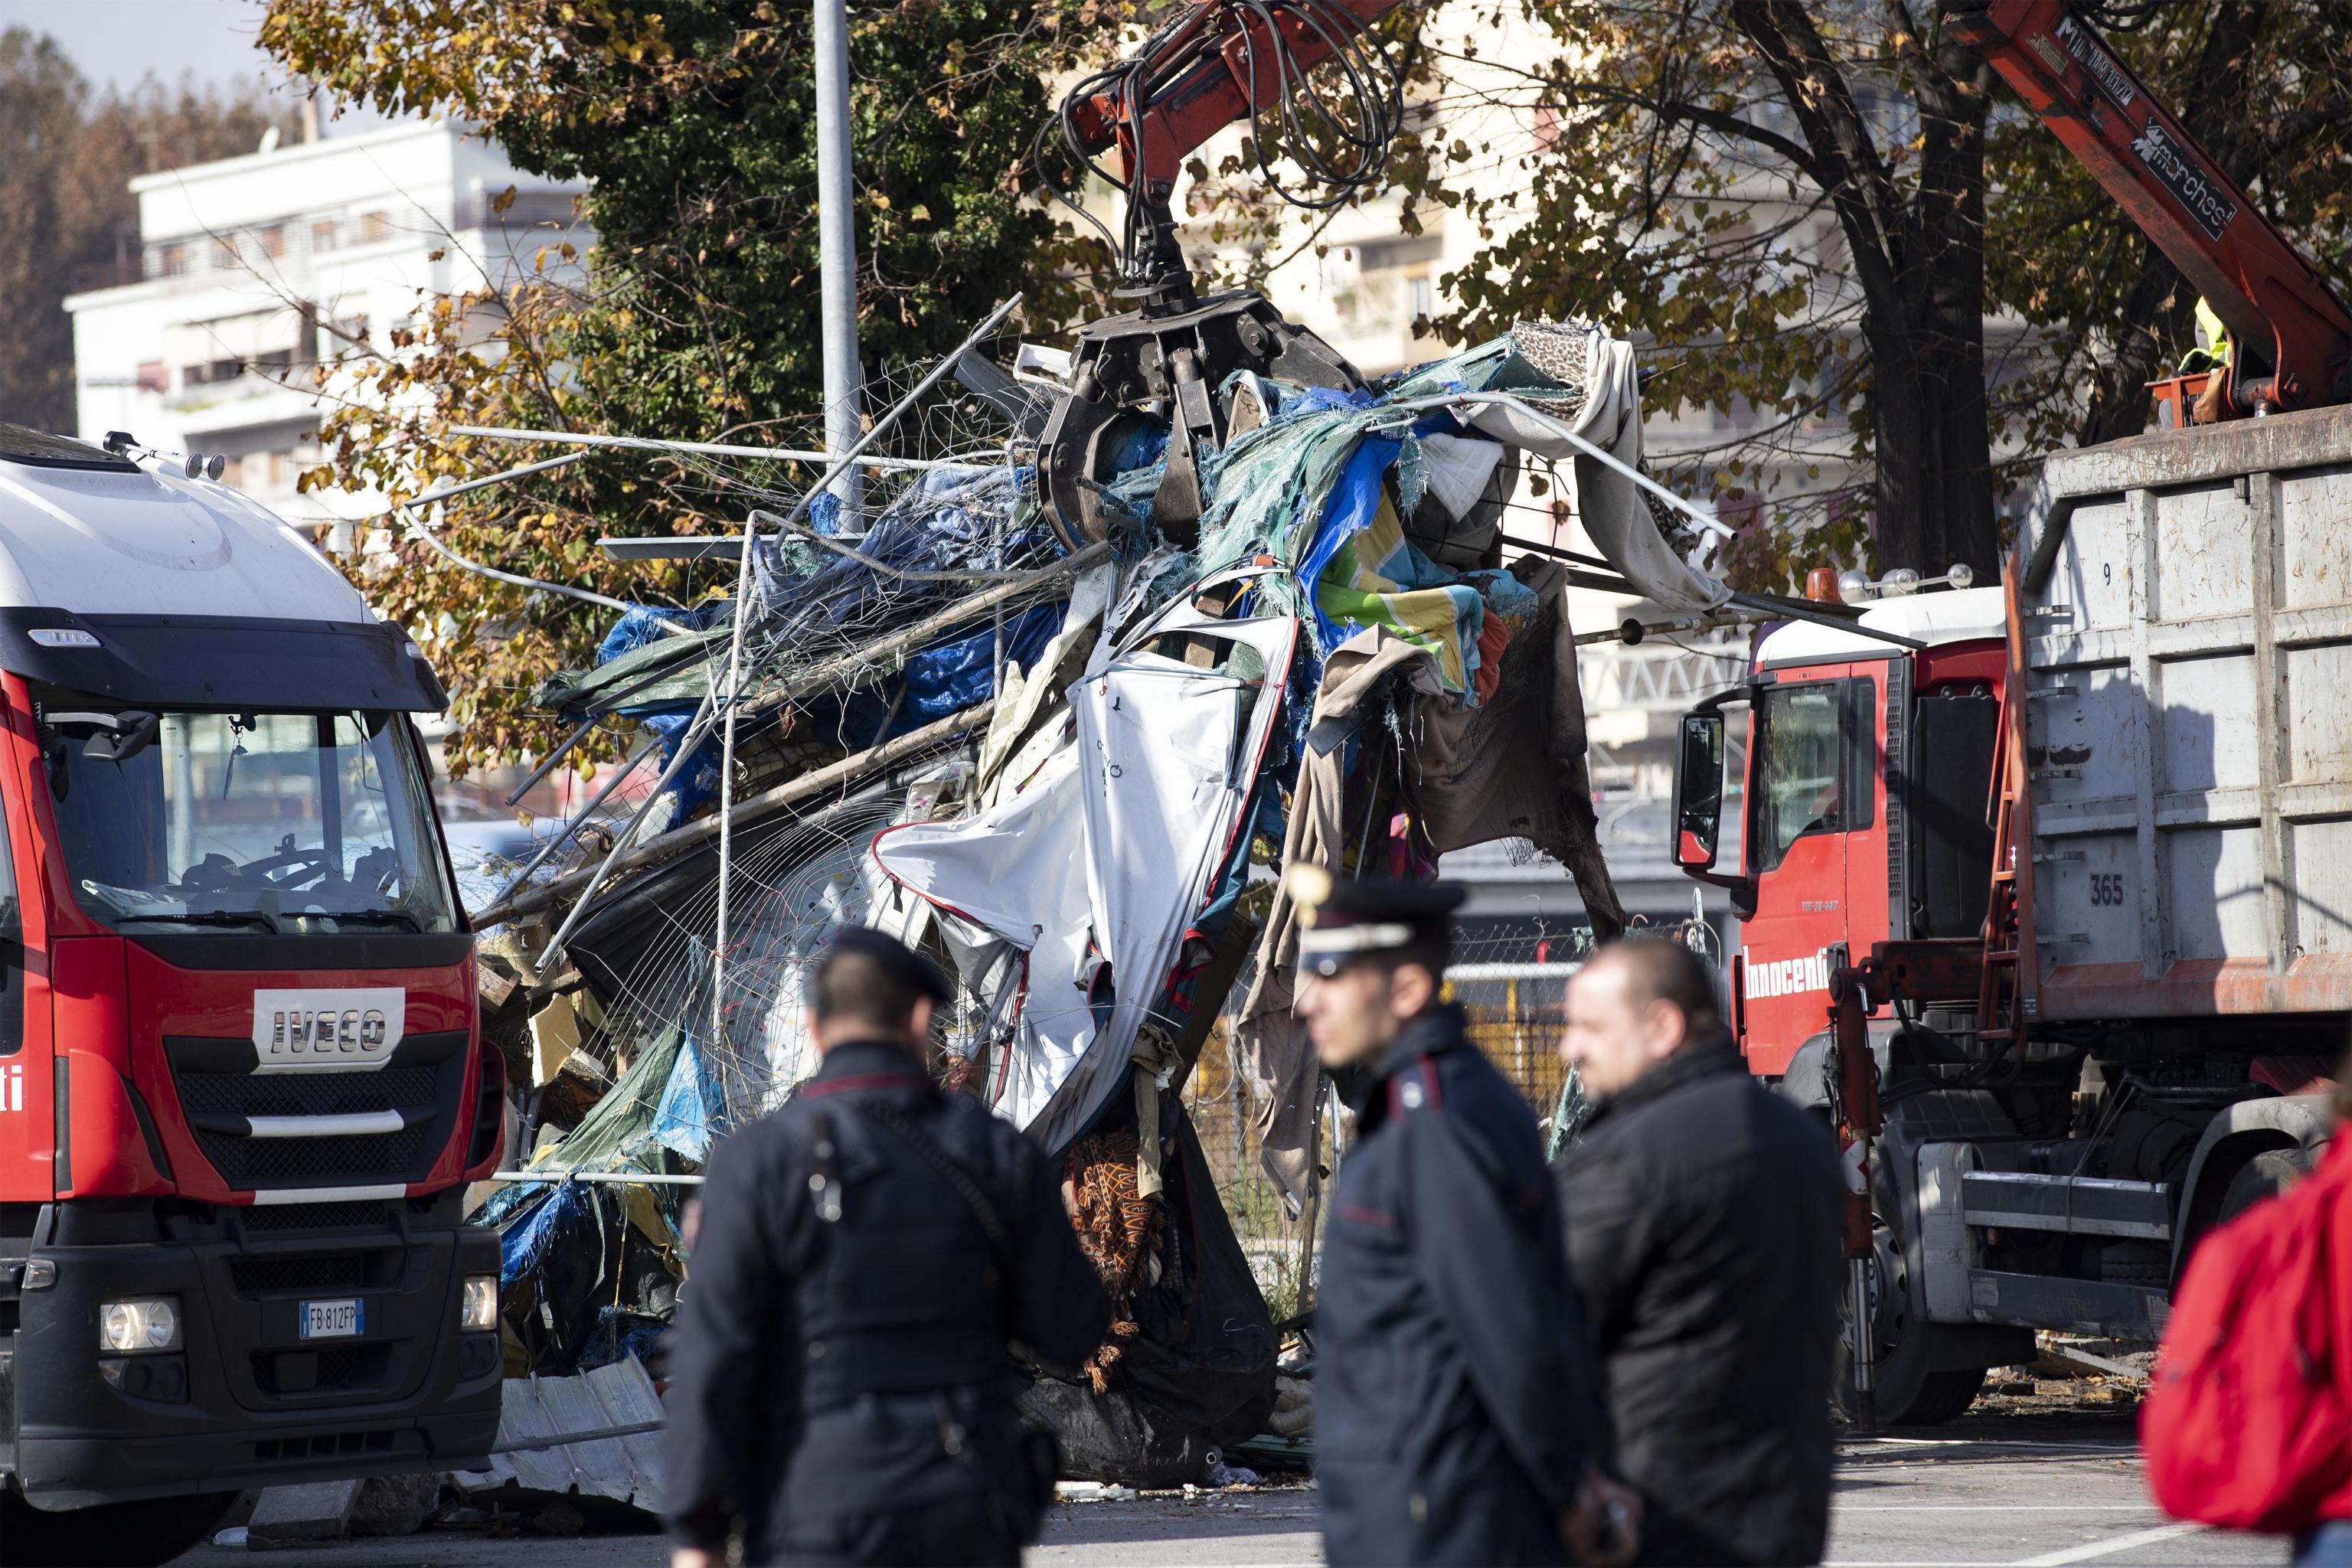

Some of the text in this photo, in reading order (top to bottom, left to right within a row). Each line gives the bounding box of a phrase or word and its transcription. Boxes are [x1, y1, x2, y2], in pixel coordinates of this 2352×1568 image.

[2103, 562, 2111, 586] 9
[2090, 874, 2124, 906] 365
[1743, 945, 1830, 1000] Innocenti
[271, 1009, 386, 1054] IVECO
